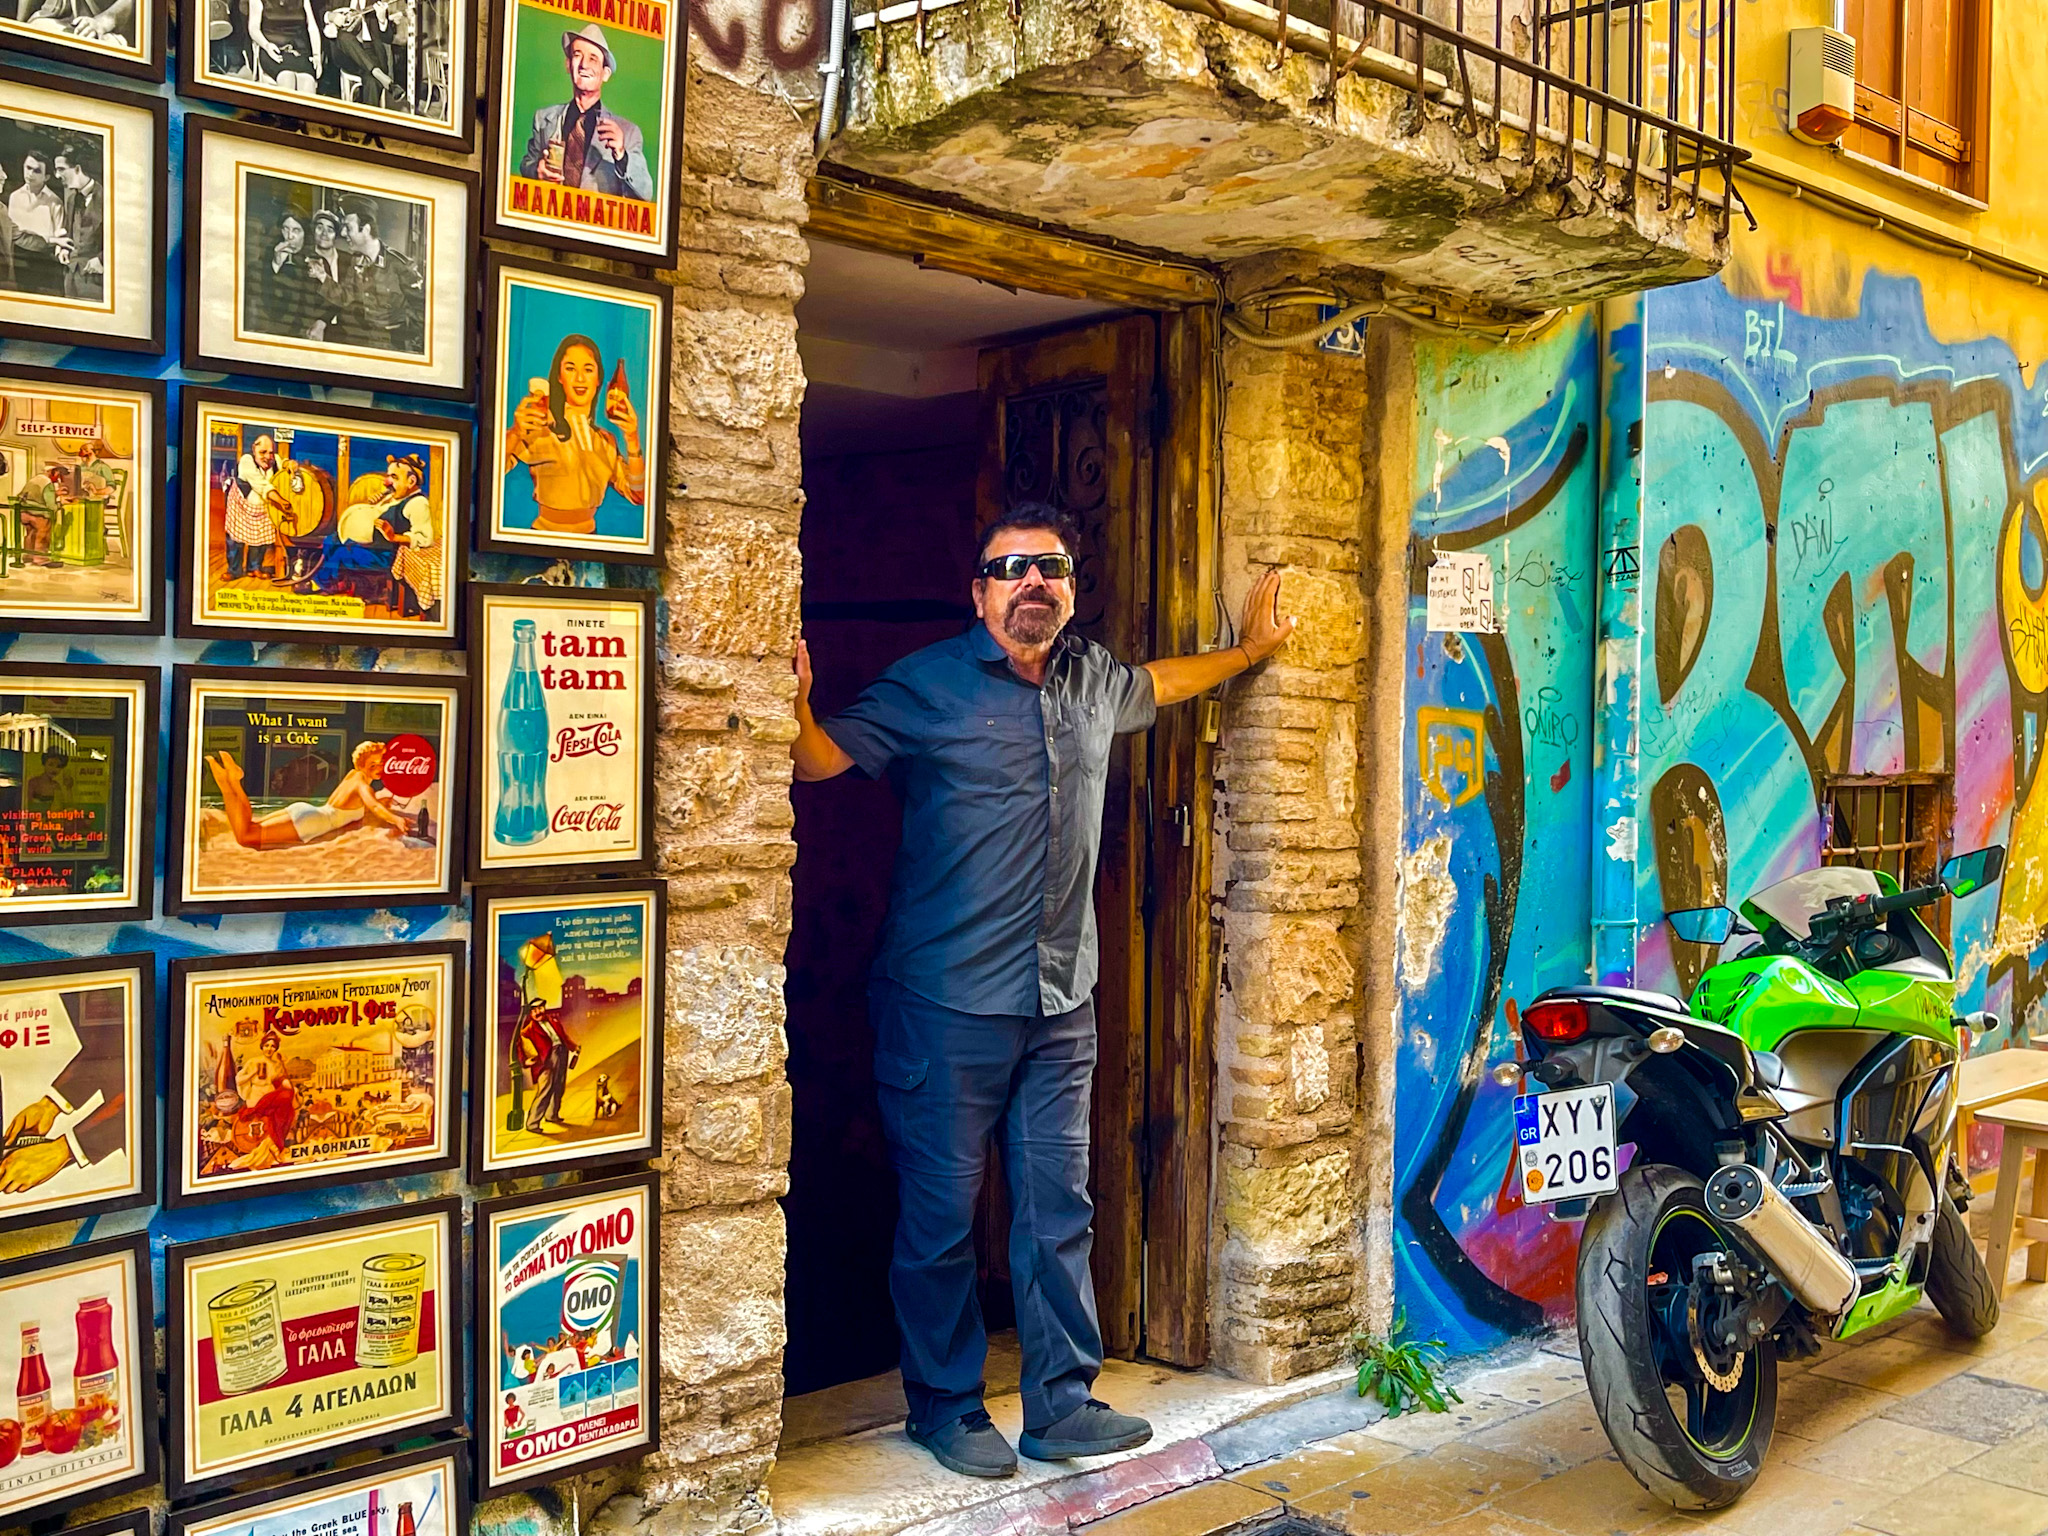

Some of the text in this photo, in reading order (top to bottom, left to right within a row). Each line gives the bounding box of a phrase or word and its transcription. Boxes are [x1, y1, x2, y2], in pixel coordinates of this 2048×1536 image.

[20, 423, 95, 437] SELF-SERVICE
[567, 619, 606, 628] ΠΙΝΕΤΕ
[541, 630, 627, 658] tam
[540, 664, 627, 691] tam
[247, 713, 328, 728] What I want
[258, 731, 319, 745] is a Coke
[2, 809, 95, 821] visiting tonight a
[551, 803, 626, 833] Coca-Cola
[20, 832, 52, 842] Greek
[56, 832, 83, 842] Gods
[27, 846, 52, 854] wine
[15, 1007, 47, 1023] μπύρα
[263, 1005, 349, 1036] ΚΑΡΟΛΟΥ
[363, 998, 397, 1026] ΦΙΞ
[0, 1024, 50, 1049] ΦΙΞ
[1520, 1126, 1538, 1141] GR
[290, 1138, 371, 1159] ΕΝ ΑΘΗΝΑΙΣ
[1545, 1146, 1611, 1189] 206
[513, 1252, 547, 1288] ΘΑΥΜΑ
[548, 1230, 578, 1268] ΤΟΥ
[566, 1284, 612, 1314] OMO
[298, 1337, 347, 1367] ΓΑΛΑ
[219, 1371, 417, 1437] ΓΑΛΑ 4 ΑΓΕΛΑΔΩΝ
[578, 1416, 607, 1433] ΠΛΕΝΕΙ
[578, 1418, 639, 1443] ΠΕΝΤΑΚΑΘΑΡΑ!
[50, 1449, 124, 1477] ΕΠΙΤΥΧΙΑ
[311, 1518, 338, 1532] Greek
[341, 1509, 367, 1524] BLUE
[342, 1525, 358, 1535] sea
